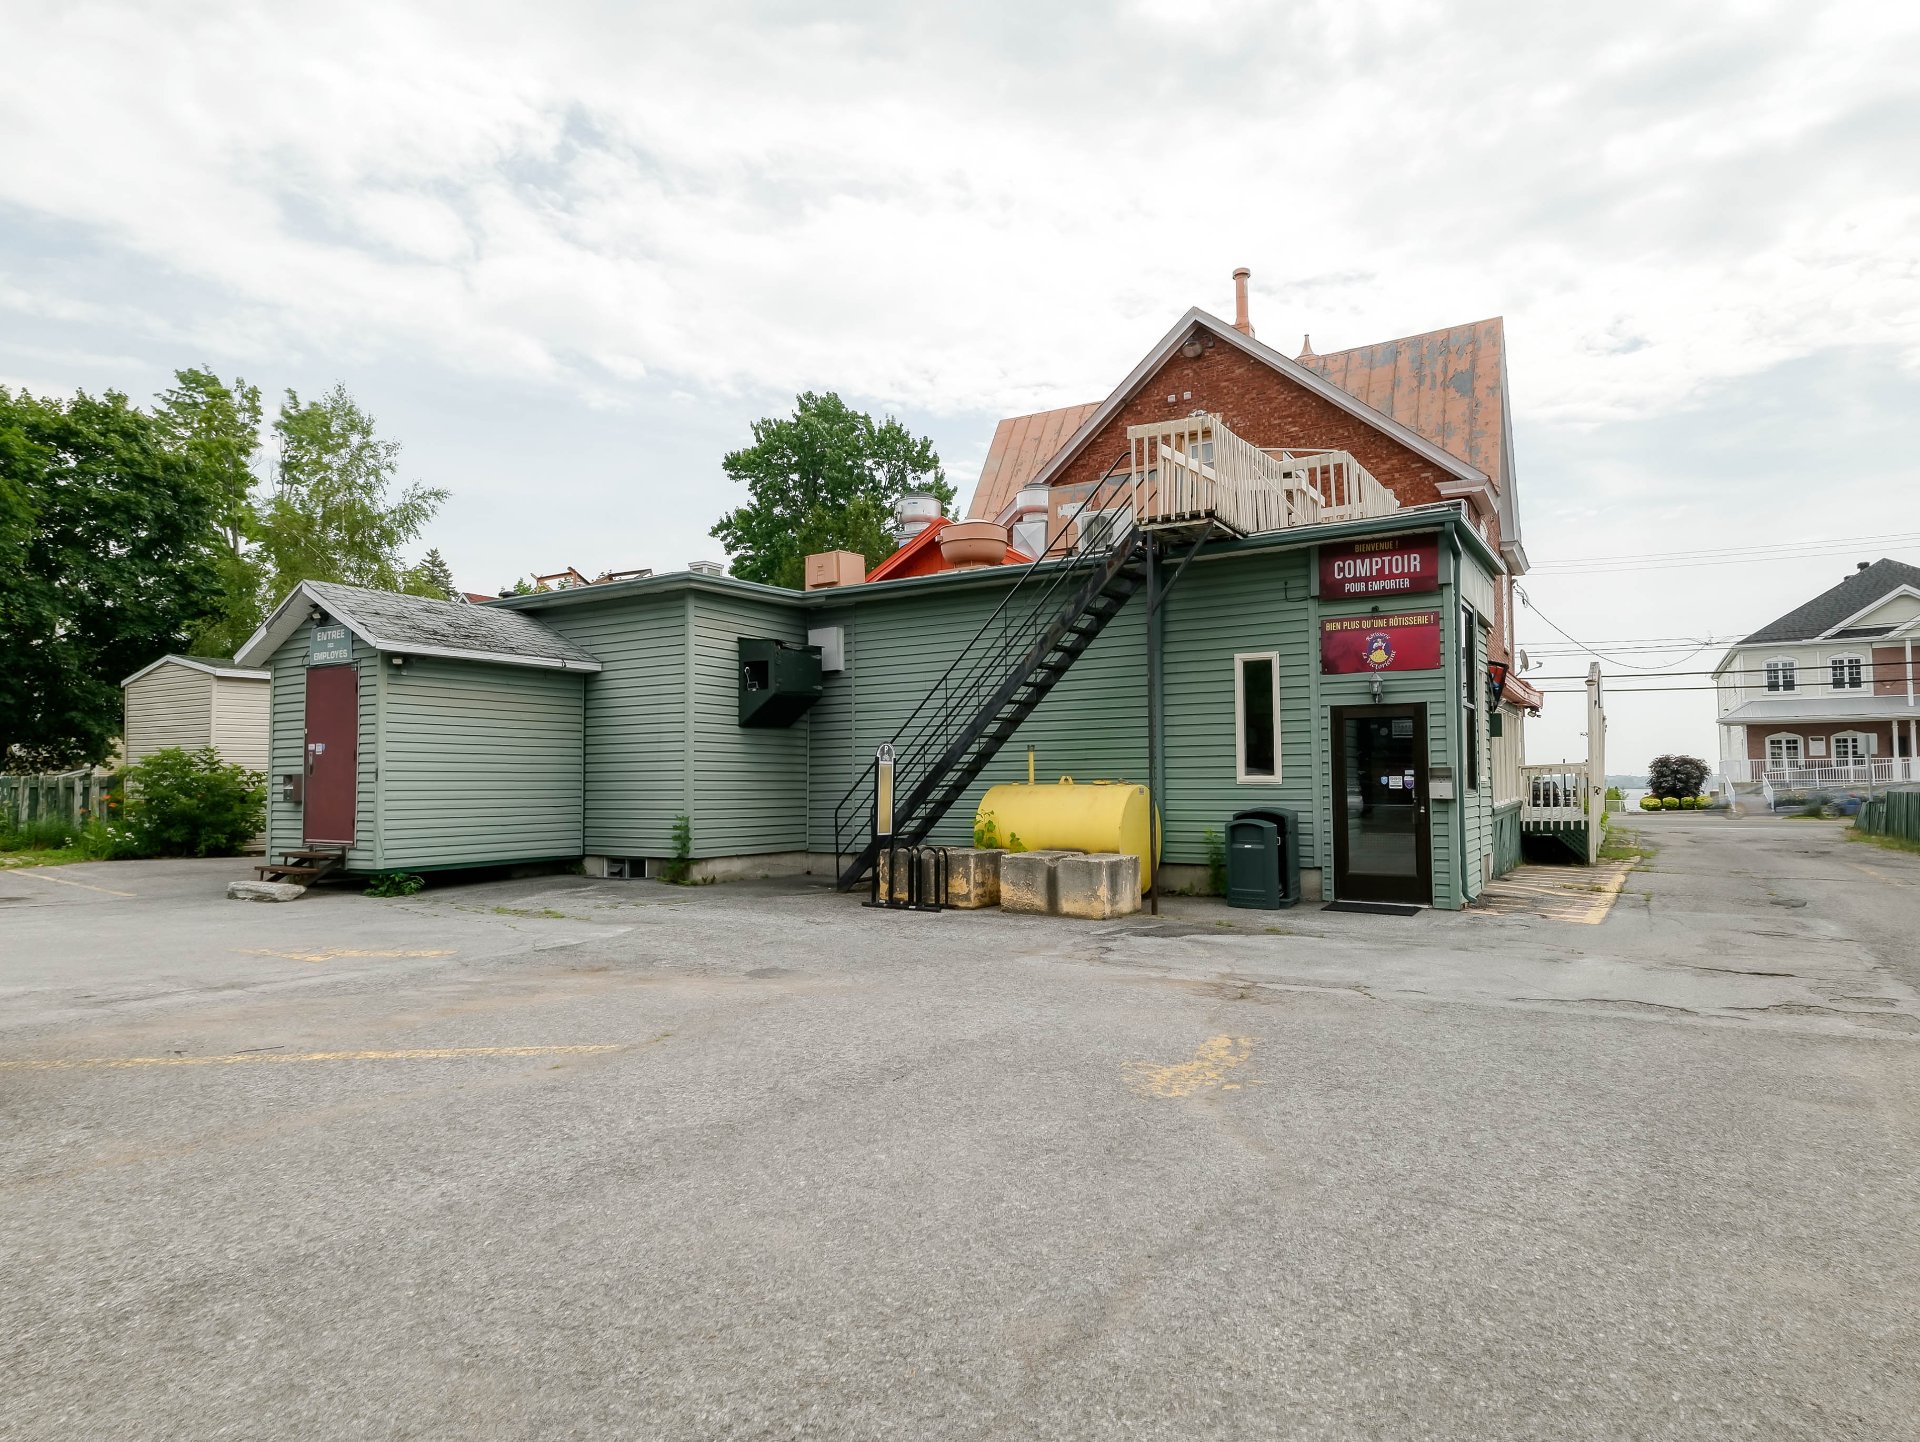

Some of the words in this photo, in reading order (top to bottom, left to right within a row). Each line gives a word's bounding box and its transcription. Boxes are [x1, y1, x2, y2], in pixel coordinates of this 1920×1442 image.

[1355, 541, 1393, 552] BIENVENUE
[1334, 553, 1420, 579] COMPTOIR
[1345, 582, 1366, 593] POUR
[1368, 578, 1410, 591] EMPORTER
[1325, 622, 1341, 631] BIEN
[1343, 620, 1360, 630] PLUS
[1361, 618, 1387, 629] QU'UNE
[1389, 615, 1428, 626] RÔTISSERIE
